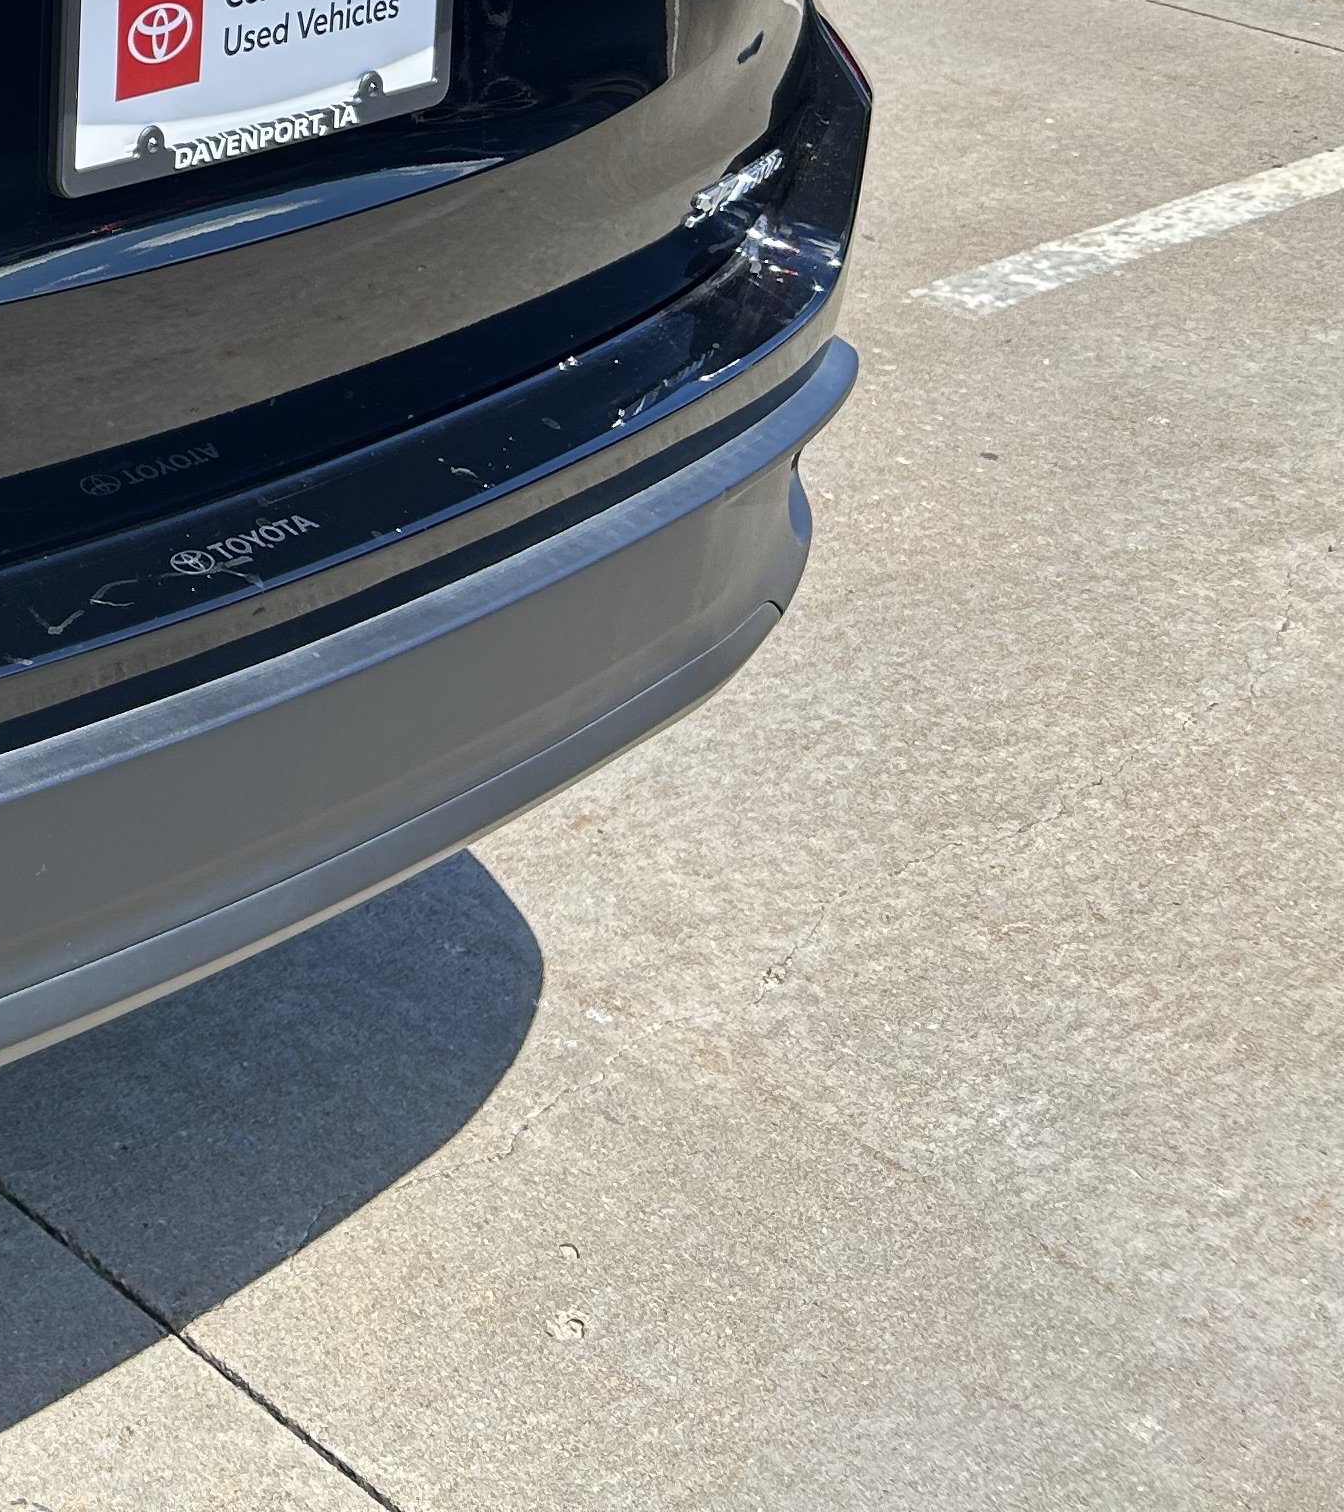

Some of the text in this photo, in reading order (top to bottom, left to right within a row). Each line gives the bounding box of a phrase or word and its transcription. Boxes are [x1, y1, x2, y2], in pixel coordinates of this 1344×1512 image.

[224, 12, 289, 56] Used
[173, 102, 359, 170] DAVENPORT, IA
[206, 514, 320, 556] TOYOTA
